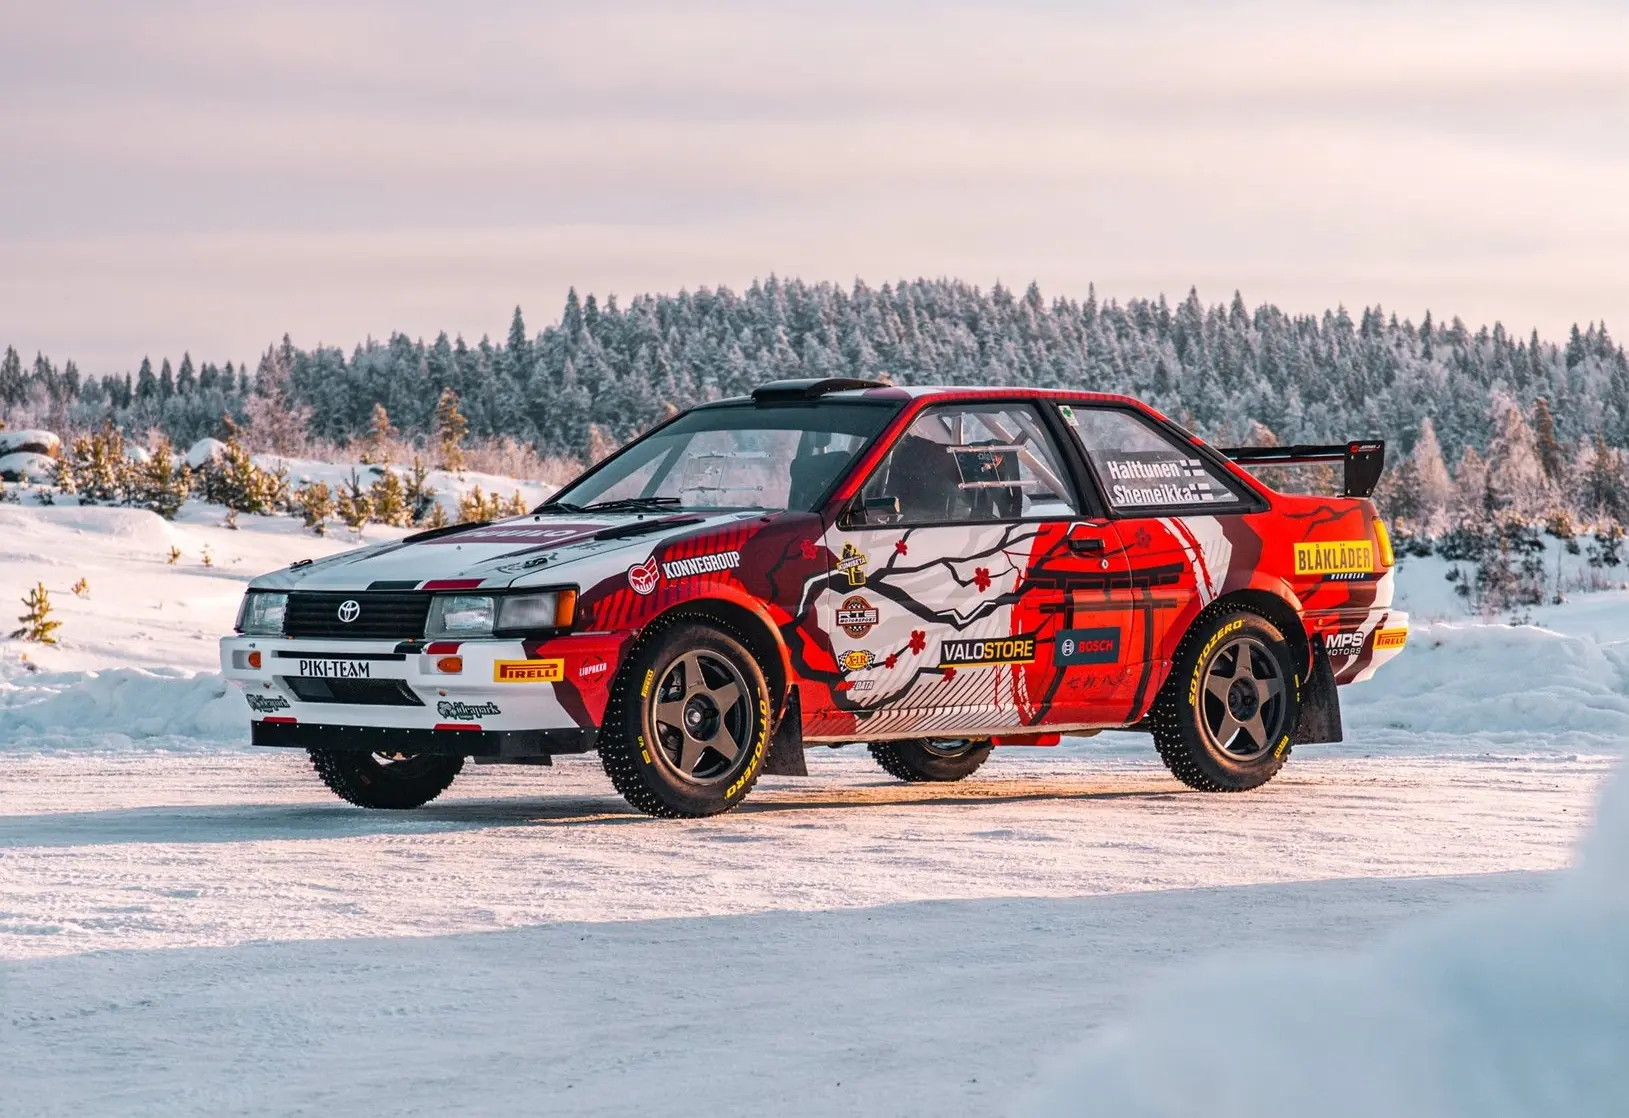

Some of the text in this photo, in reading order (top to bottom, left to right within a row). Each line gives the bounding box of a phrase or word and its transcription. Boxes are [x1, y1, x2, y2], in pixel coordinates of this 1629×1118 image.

[1107, 460, 1180, 480] Halttunen
[1113, 484, 1192, 504] Shemeikka
[662, 551, 740, 579] KONNEGROUP
[1298, 543, 1371, 571] BLÅKLÄDER
[944, 640, 1034, 661] VALOSTORE
[1078, 640, 1114, 653] BOSCH
[1326, 633, 1363, 648] MPS
[300, 660, 370, 678] PIKI-TEAM
[500, 664, 559, 679] PIRELLI
[1188, 619, 1243, 707] SOTTOZERO
